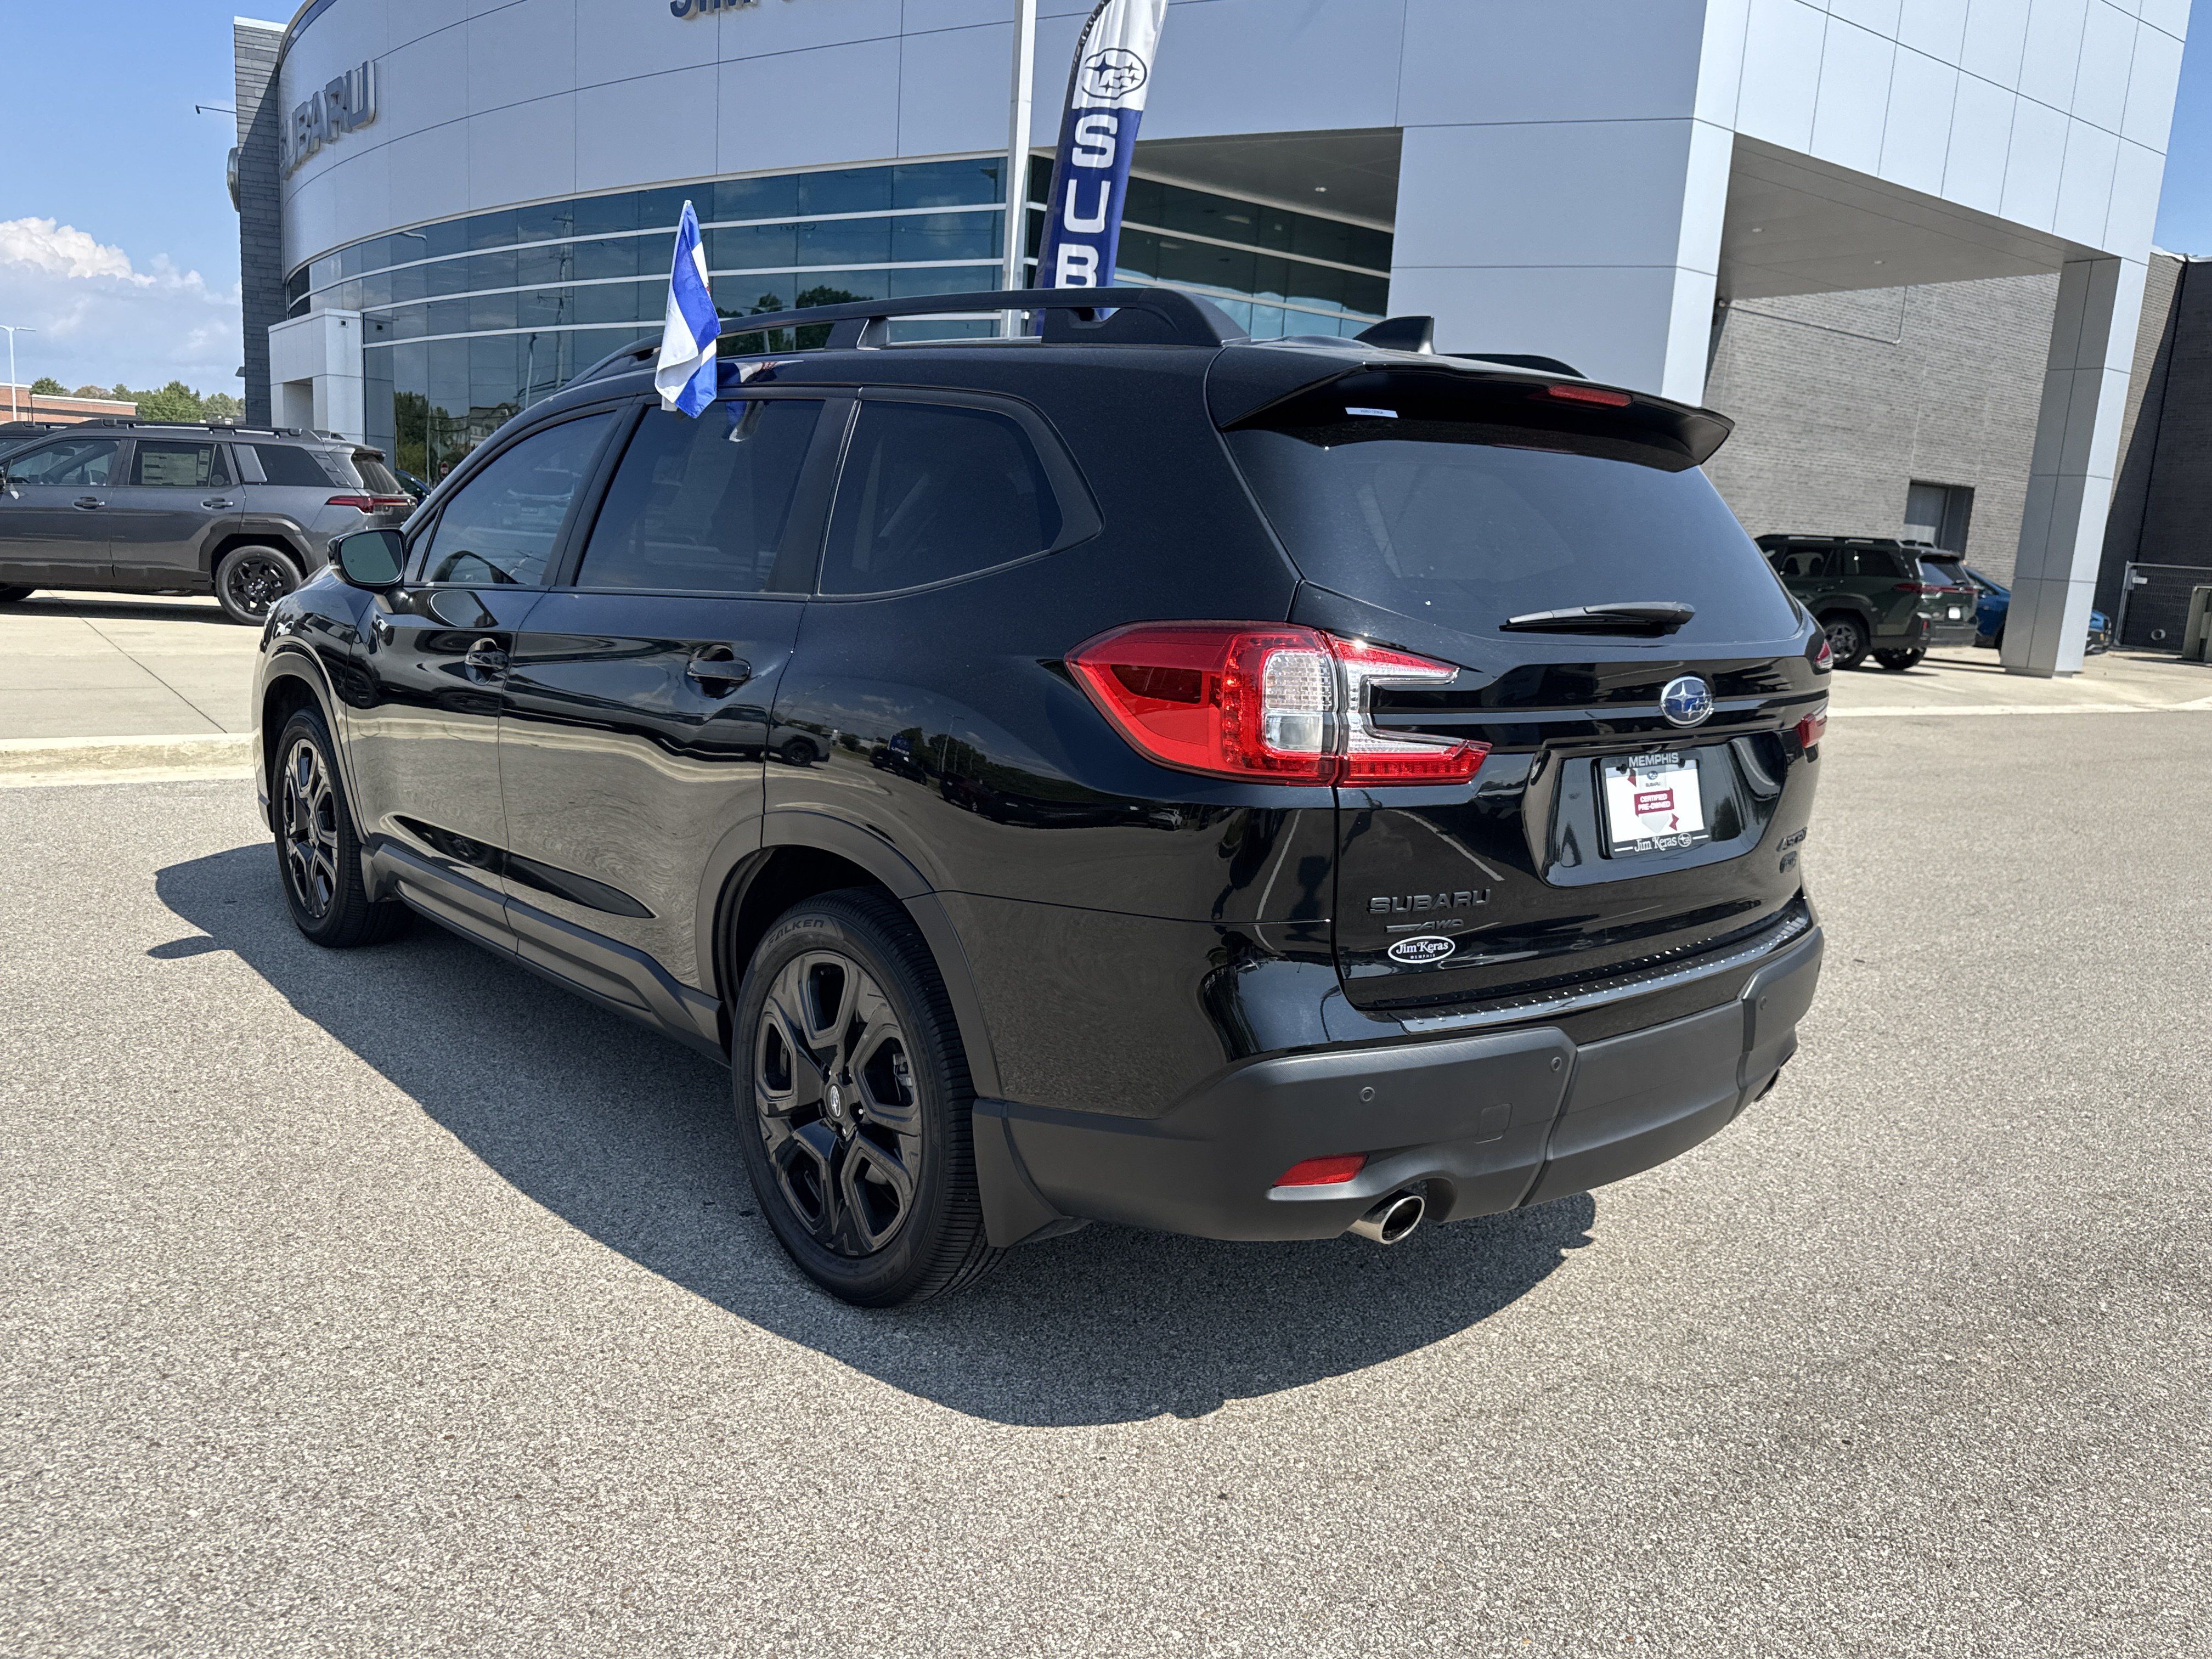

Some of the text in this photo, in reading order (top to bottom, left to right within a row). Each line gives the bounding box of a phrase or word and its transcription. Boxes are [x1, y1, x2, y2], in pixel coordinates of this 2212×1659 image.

[1628, 752, 1679, 768] MEMPHIS
[1640, 793, 1668, 803] CERTIFIED
[1638, 801, 1671, 811] PRE-OWNED
[1634, 836, 1677, 852] Jim Keras
[1368, 889, 1491, 914] SUBARU
[1416, 918, 1464, 931] AWD
[1396, 941, 1448, 954] Jim Keras
